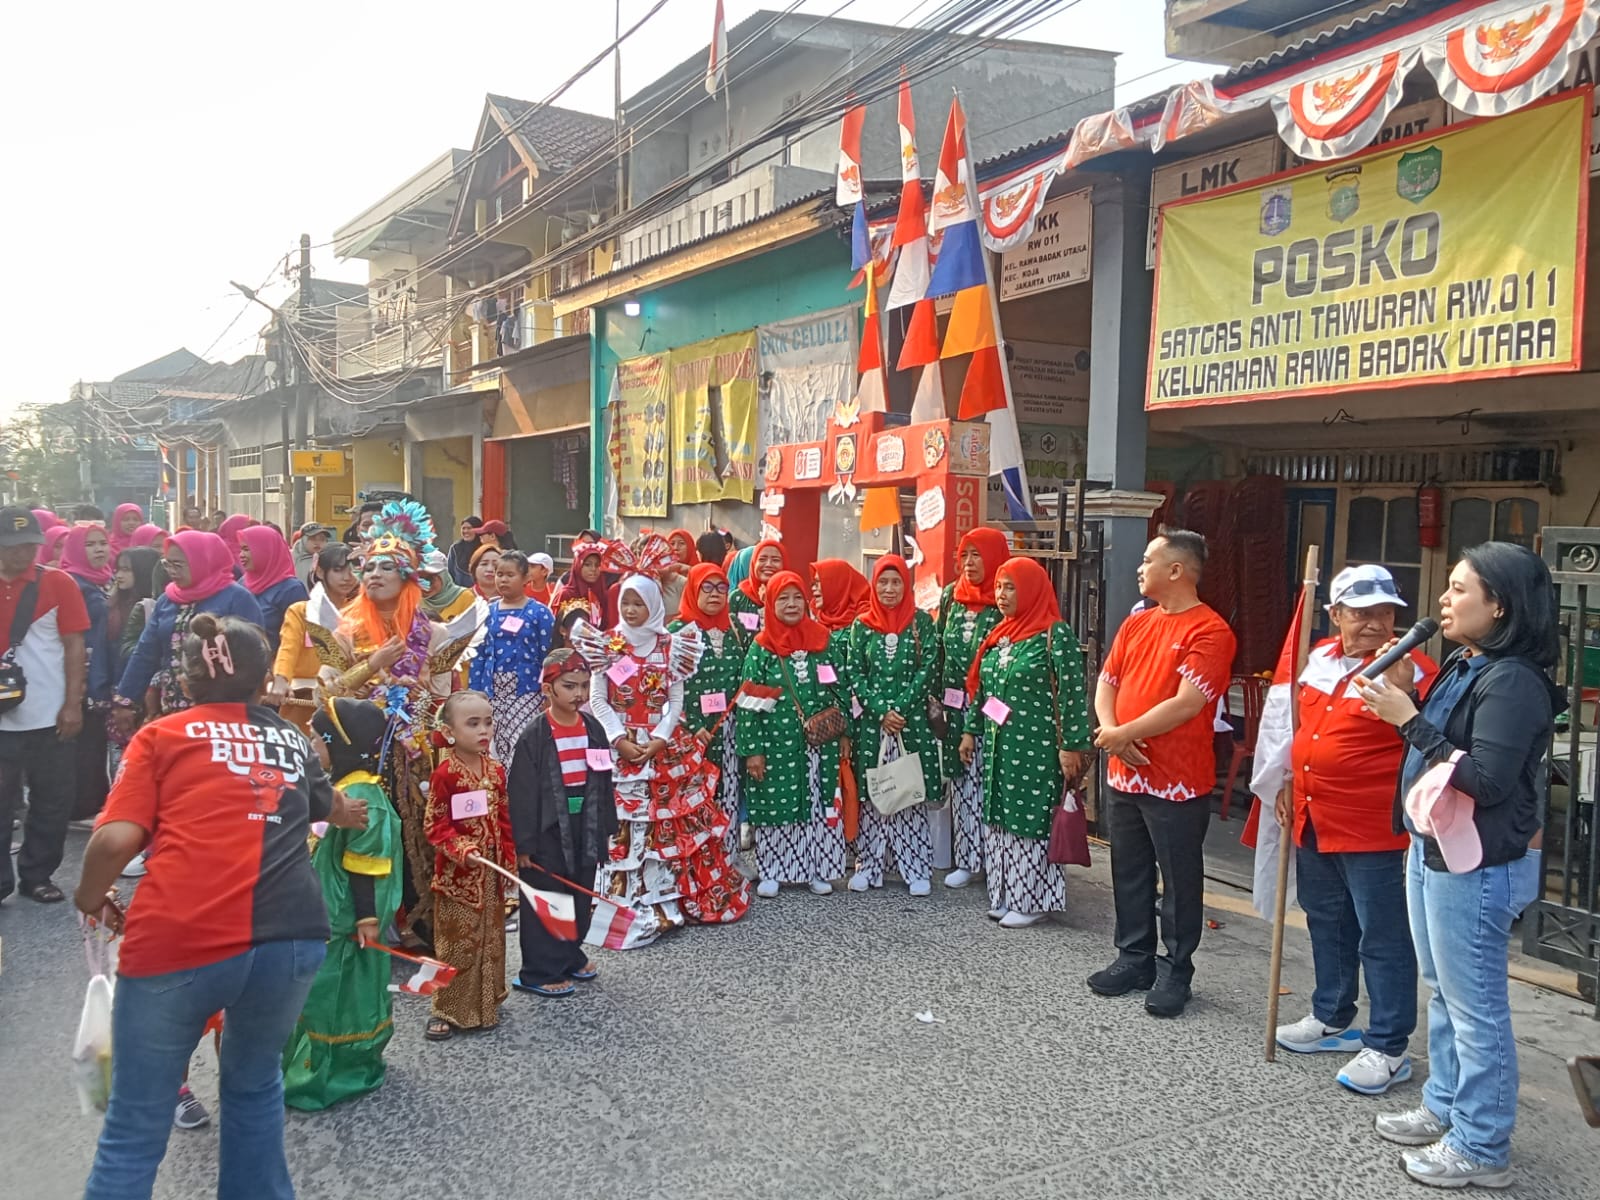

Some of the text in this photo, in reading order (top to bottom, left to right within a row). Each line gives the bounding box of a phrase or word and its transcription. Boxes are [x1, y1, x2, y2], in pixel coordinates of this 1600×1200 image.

[1181, 157, 1241, 197] LMK
[1036, 211, 1060, 232] KK
[1019, 256, 1038, 267] RAWA
[1038, 250, 1061, 264] BADAK
[1063, 244, 1087, 257] UTARA
[1027, 233, 1060, 251] RW 011
[1251, 211, 1441, 306] POSKO
[1014, 271, 1071, 291] JAKARTA UTARA
[1159, 267, 1558, 361] SATGAS ANTI TAWURAN RW.011
[1156, 317, 1557, 399] KELURAHAN RAWA BADAK UTARA
[185, 721, 309, 759] CHICAGO
[210, 739, 306, 778] BULLS
[464, 798, 474, 812] 8
